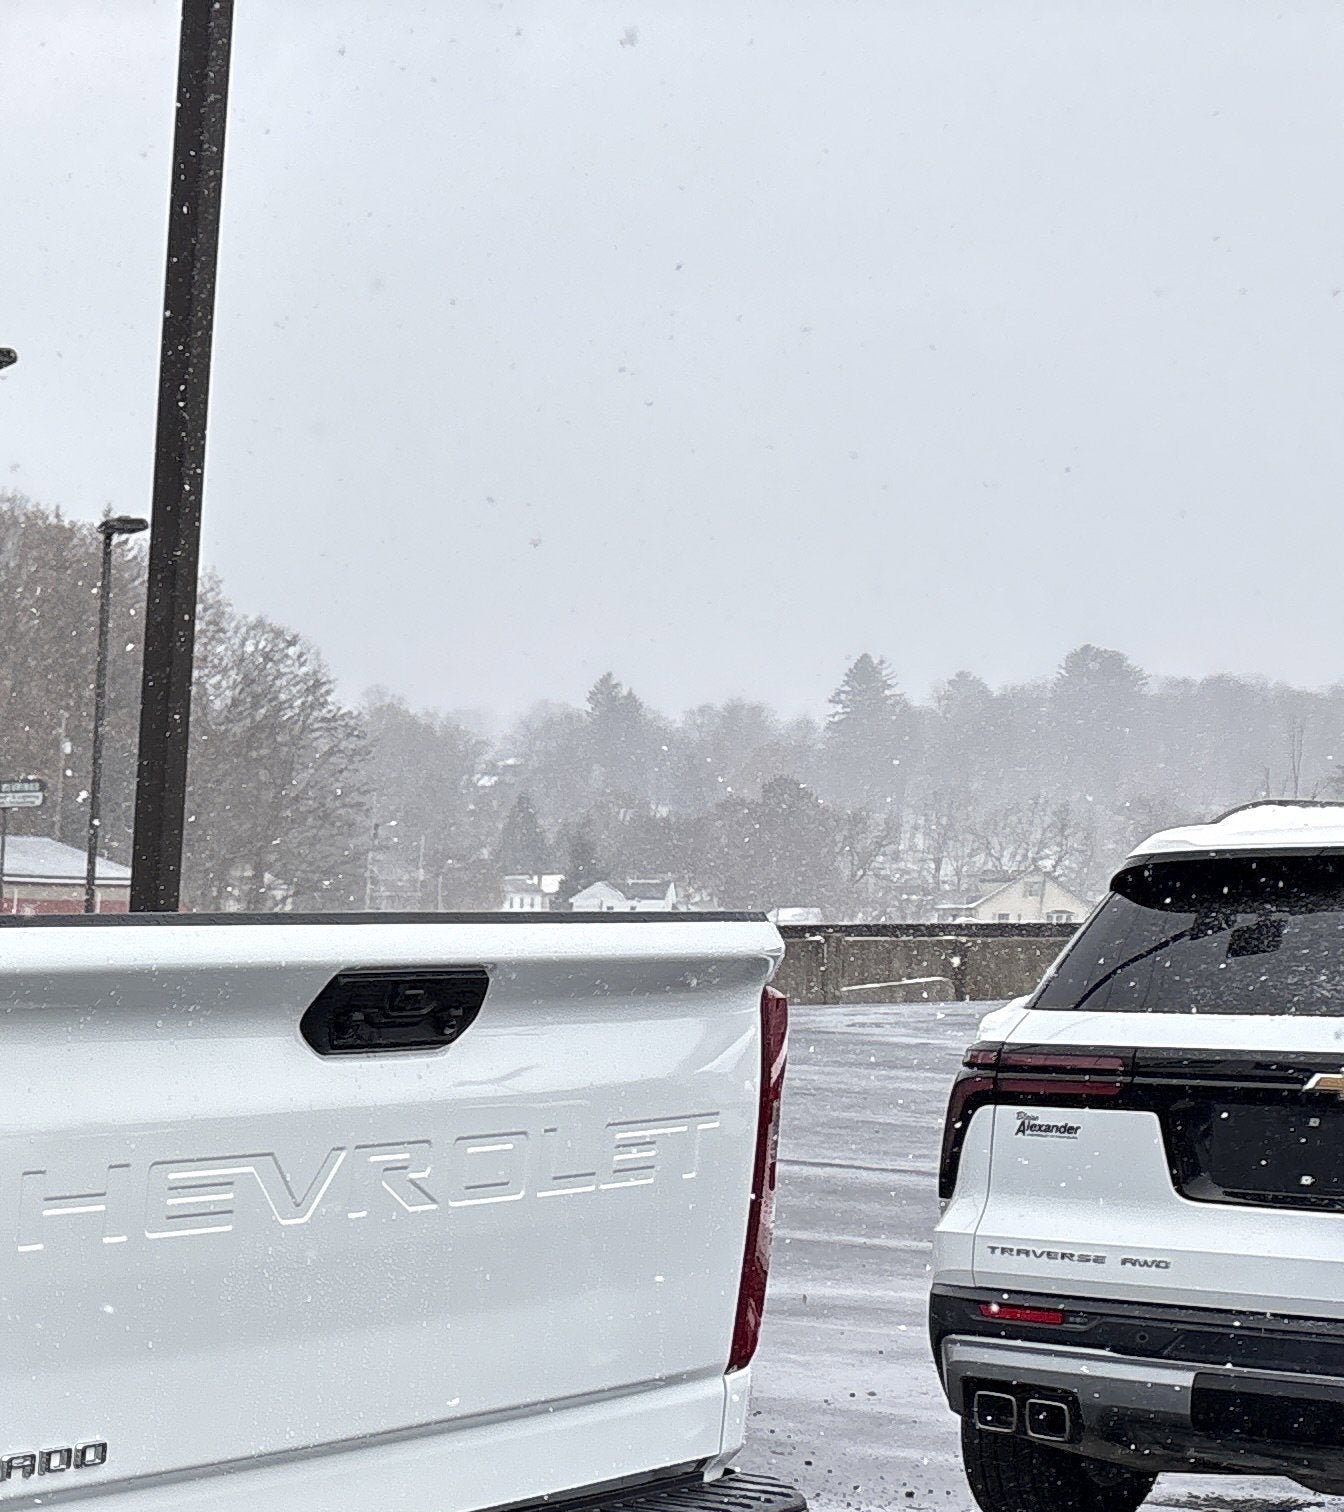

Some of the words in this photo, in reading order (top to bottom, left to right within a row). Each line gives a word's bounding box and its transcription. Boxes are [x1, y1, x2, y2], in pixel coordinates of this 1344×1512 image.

[1015, 1120, 1082, 1136] Alexander
[987, 1246, 1107, 1264] TRAVERSE
[1120, 1257, 1171, 1270] AWD
